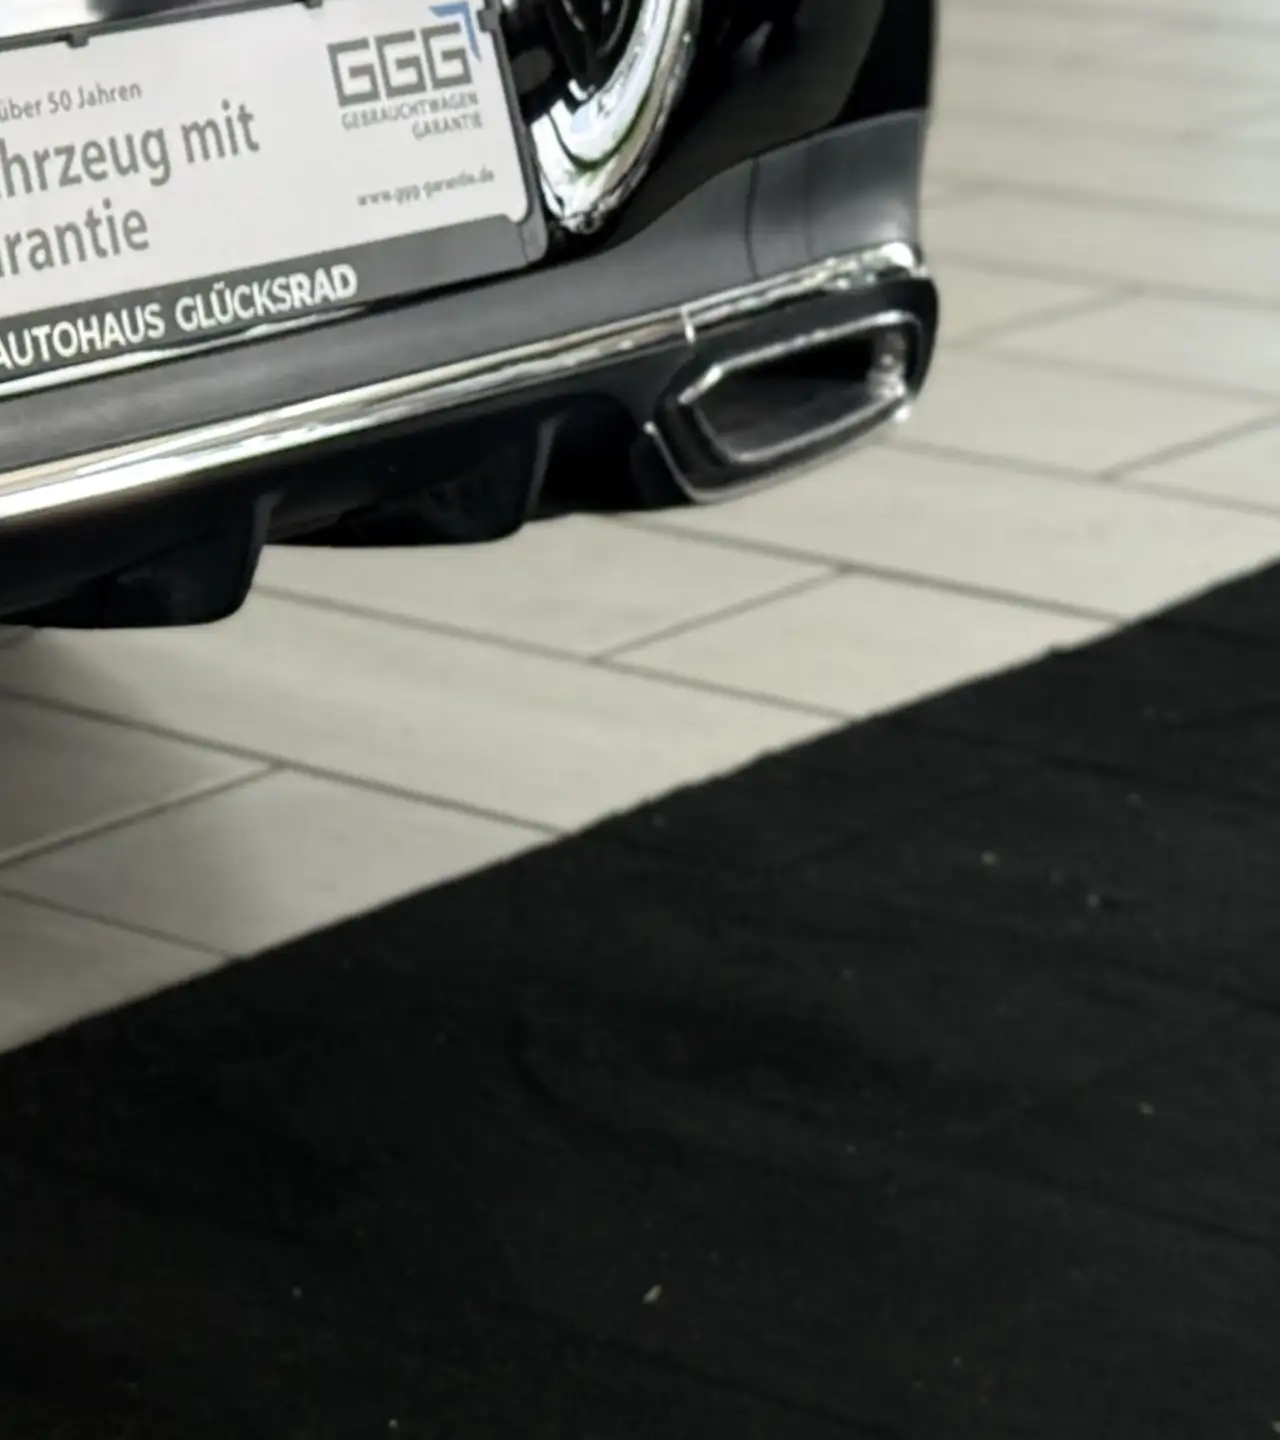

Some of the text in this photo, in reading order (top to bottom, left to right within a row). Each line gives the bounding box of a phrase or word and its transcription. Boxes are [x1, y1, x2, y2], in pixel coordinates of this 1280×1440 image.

[328, 23, 472, 107] GGG
[47, 89, 72, 114] 50
[77, 82, 142, 109] Jahren
[341, 92, 478, 131] GEBRAUCHTWAGEN
[181, 99, 260, 164] mit
[411, 111, 483, 141] GARANTIE
[175, 262, 358, 332] GLÜCKSRAD
